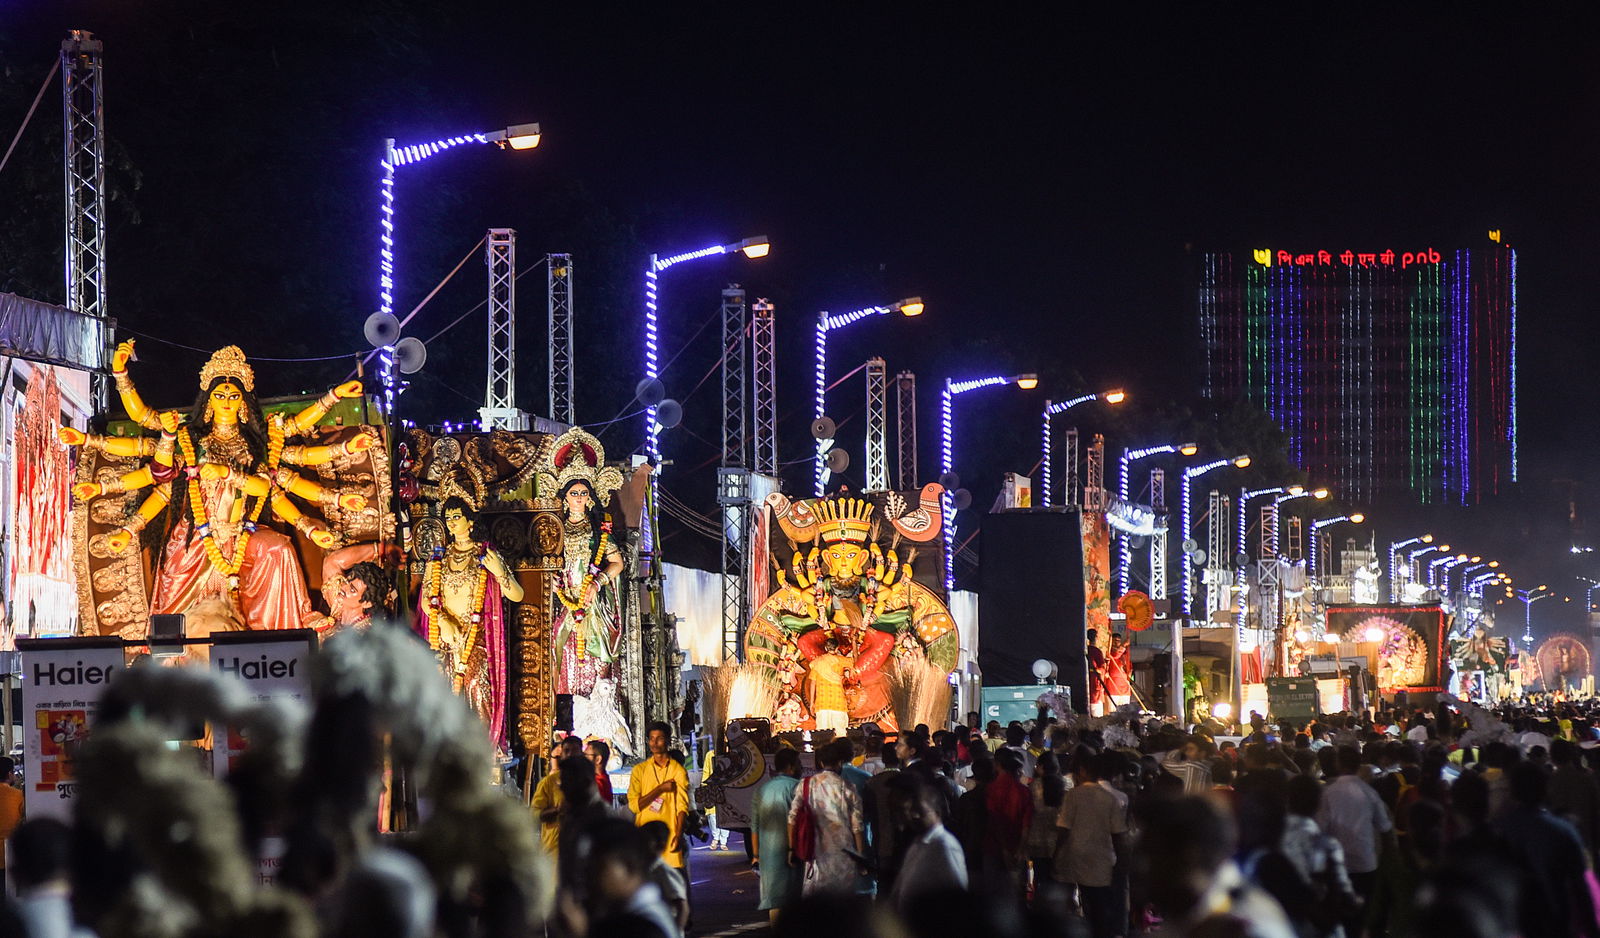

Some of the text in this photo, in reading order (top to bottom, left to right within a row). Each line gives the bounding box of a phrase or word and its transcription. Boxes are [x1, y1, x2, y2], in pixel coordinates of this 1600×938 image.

[1402, 247, 1441, 269] pnb
[33, 660, 114, 686] Haier
[218, 655, 297, 680] Haier
